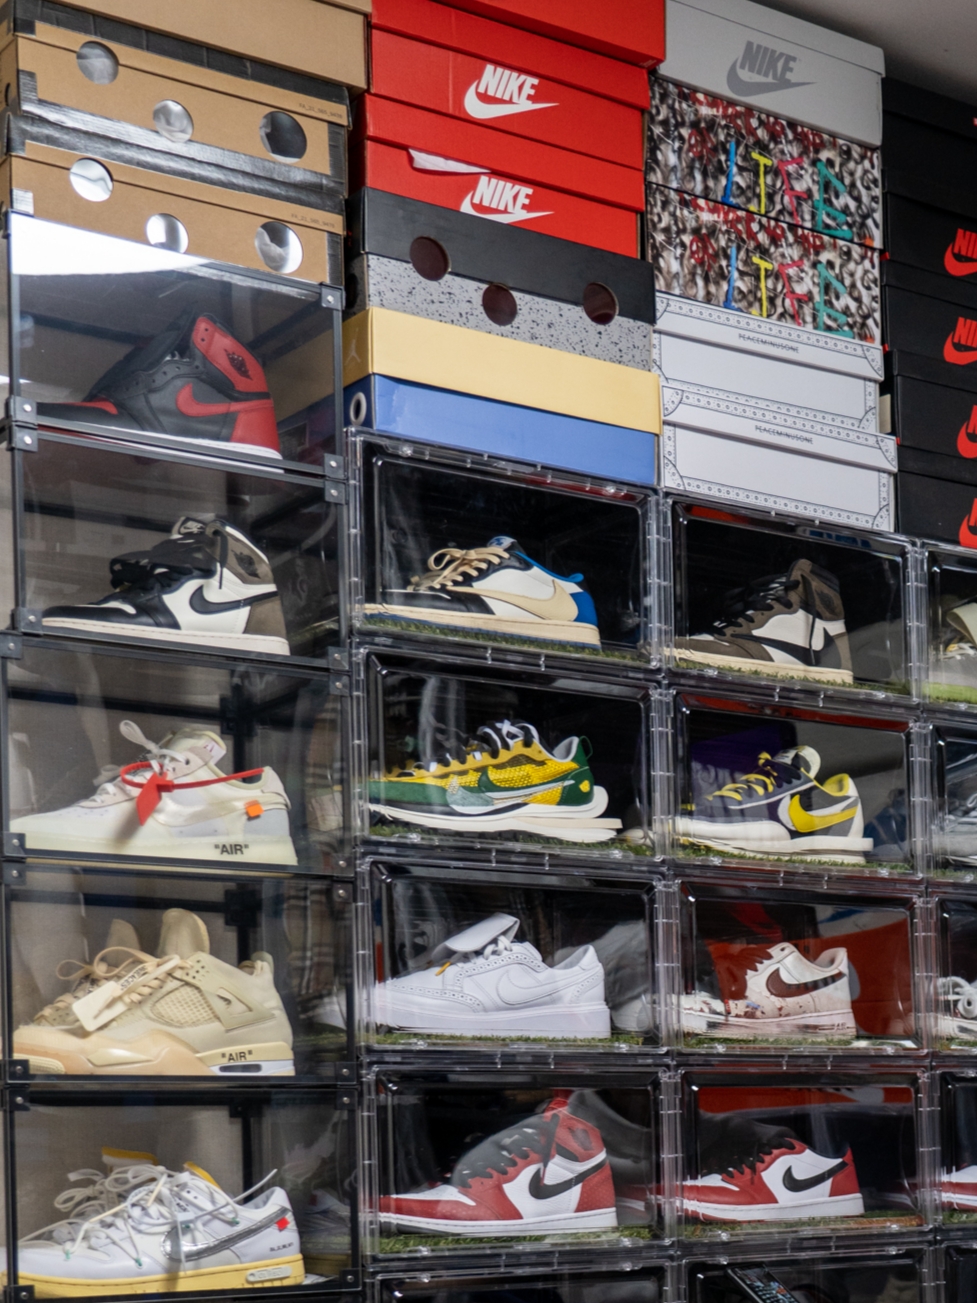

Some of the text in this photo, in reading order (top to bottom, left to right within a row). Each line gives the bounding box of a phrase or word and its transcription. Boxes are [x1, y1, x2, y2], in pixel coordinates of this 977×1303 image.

[739, 40, 797, 83] NIKE
[477, 64, 539, 104] NIKE
[472, 175, 533, 213] NIKE
[739, 333, 799, 353] PEACEMINUSONE
[755, 424, 814, 444] PEACEMINUSONE
[214, 844, 249, 855] "AIR"
[221, 1050, 252, 1063] "AIR"
